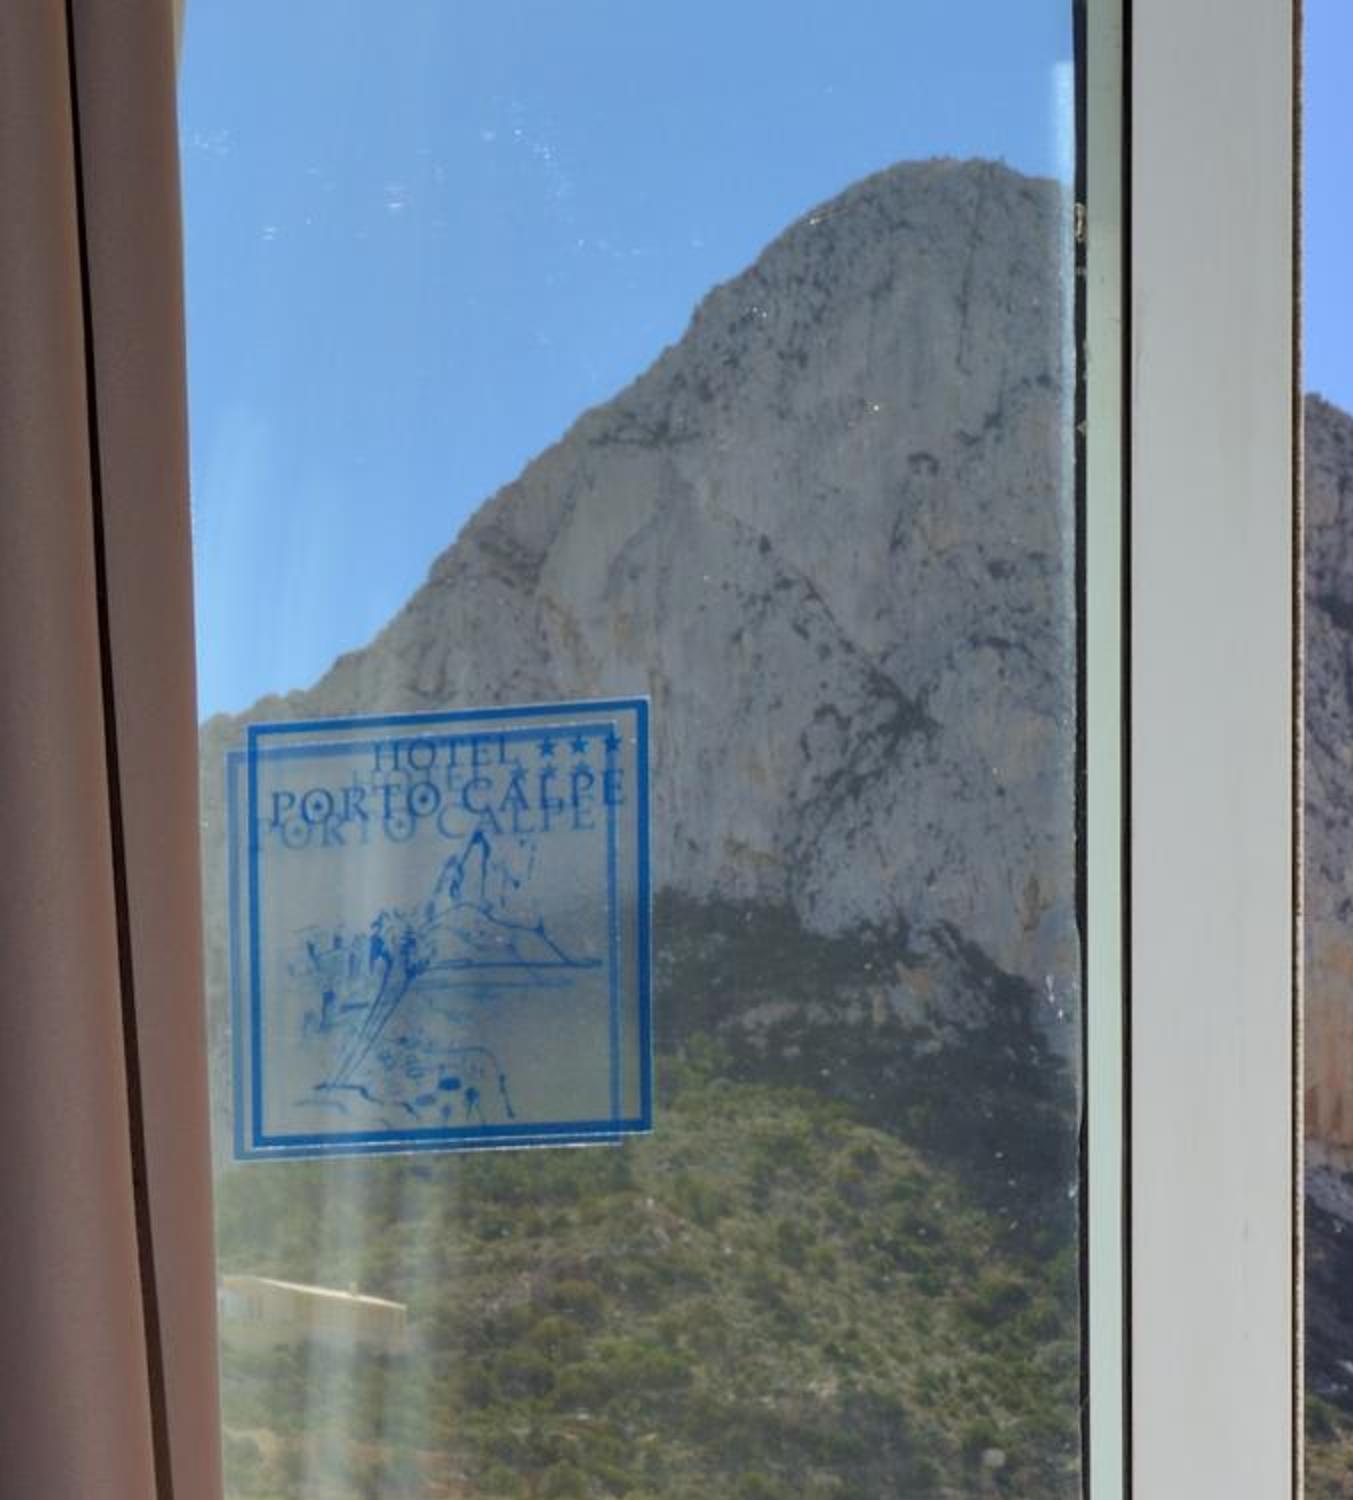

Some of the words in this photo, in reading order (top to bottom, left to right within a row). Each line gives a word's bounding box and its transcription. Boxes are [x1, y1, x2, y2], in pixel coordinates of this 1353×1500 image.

[372, 735, 518, 773] HOTEL
[271, 781, 441, 828] PORTO
[461, 768, 625, 815] CALPE
